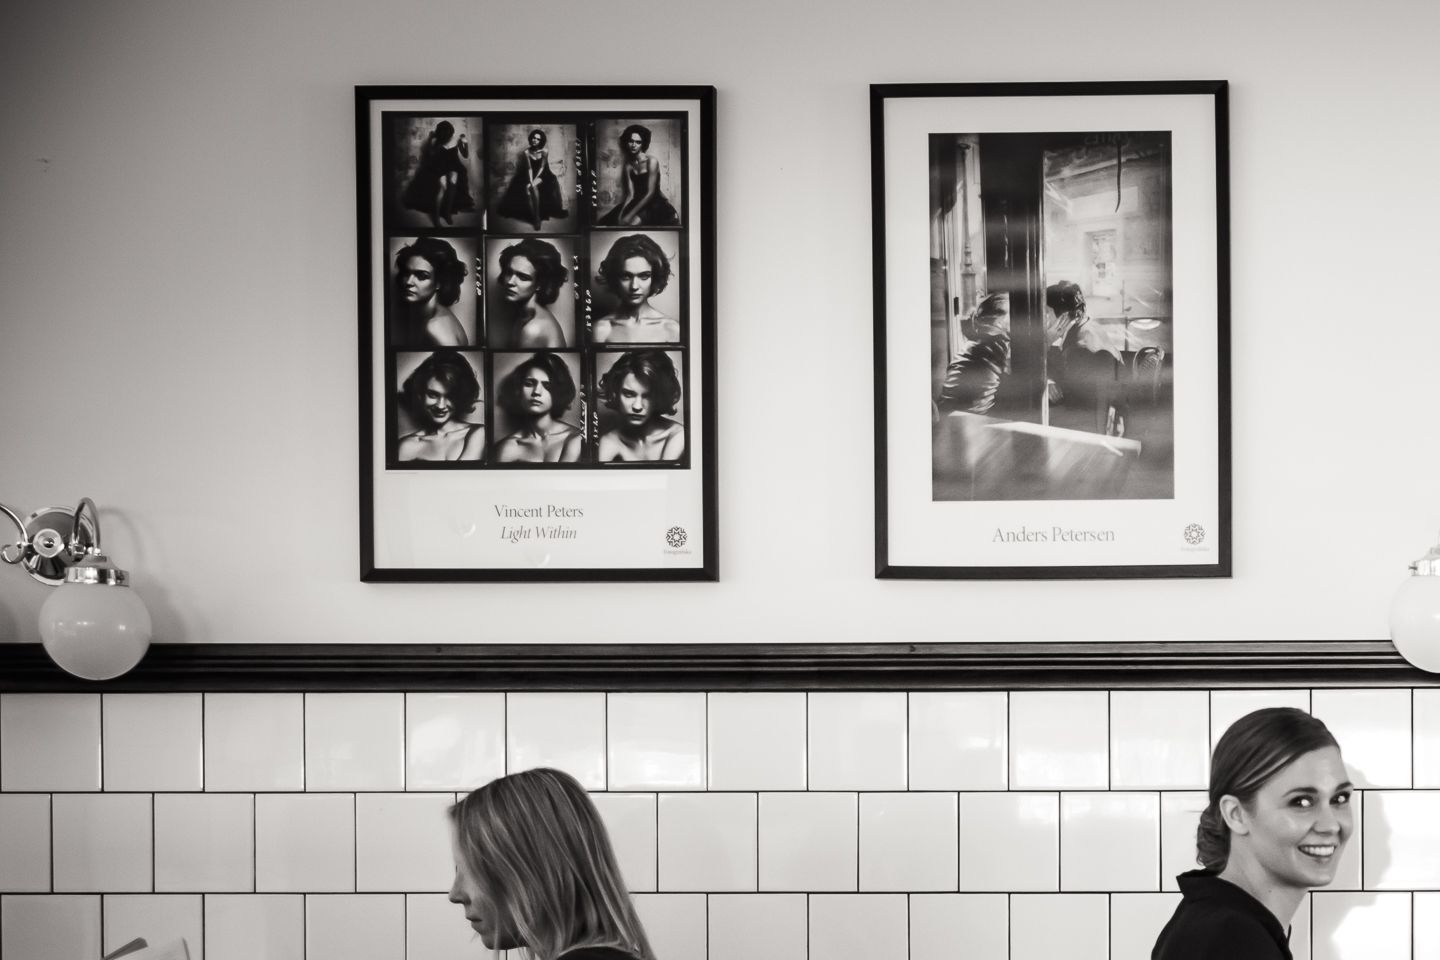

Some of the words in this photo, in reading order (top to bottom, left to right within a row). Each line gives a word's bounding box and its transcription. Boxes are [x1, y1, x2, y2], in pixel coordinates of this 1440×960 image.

[494, 504, 543, 518] Vincent
[547, 504, 584, 518] Peters
[501, 525, 532, 543] Light
[535, 525, 577, 539] Within
[992, 525, 1048, 542] Anders
[1052, 526, 1115, 542] Petersen
